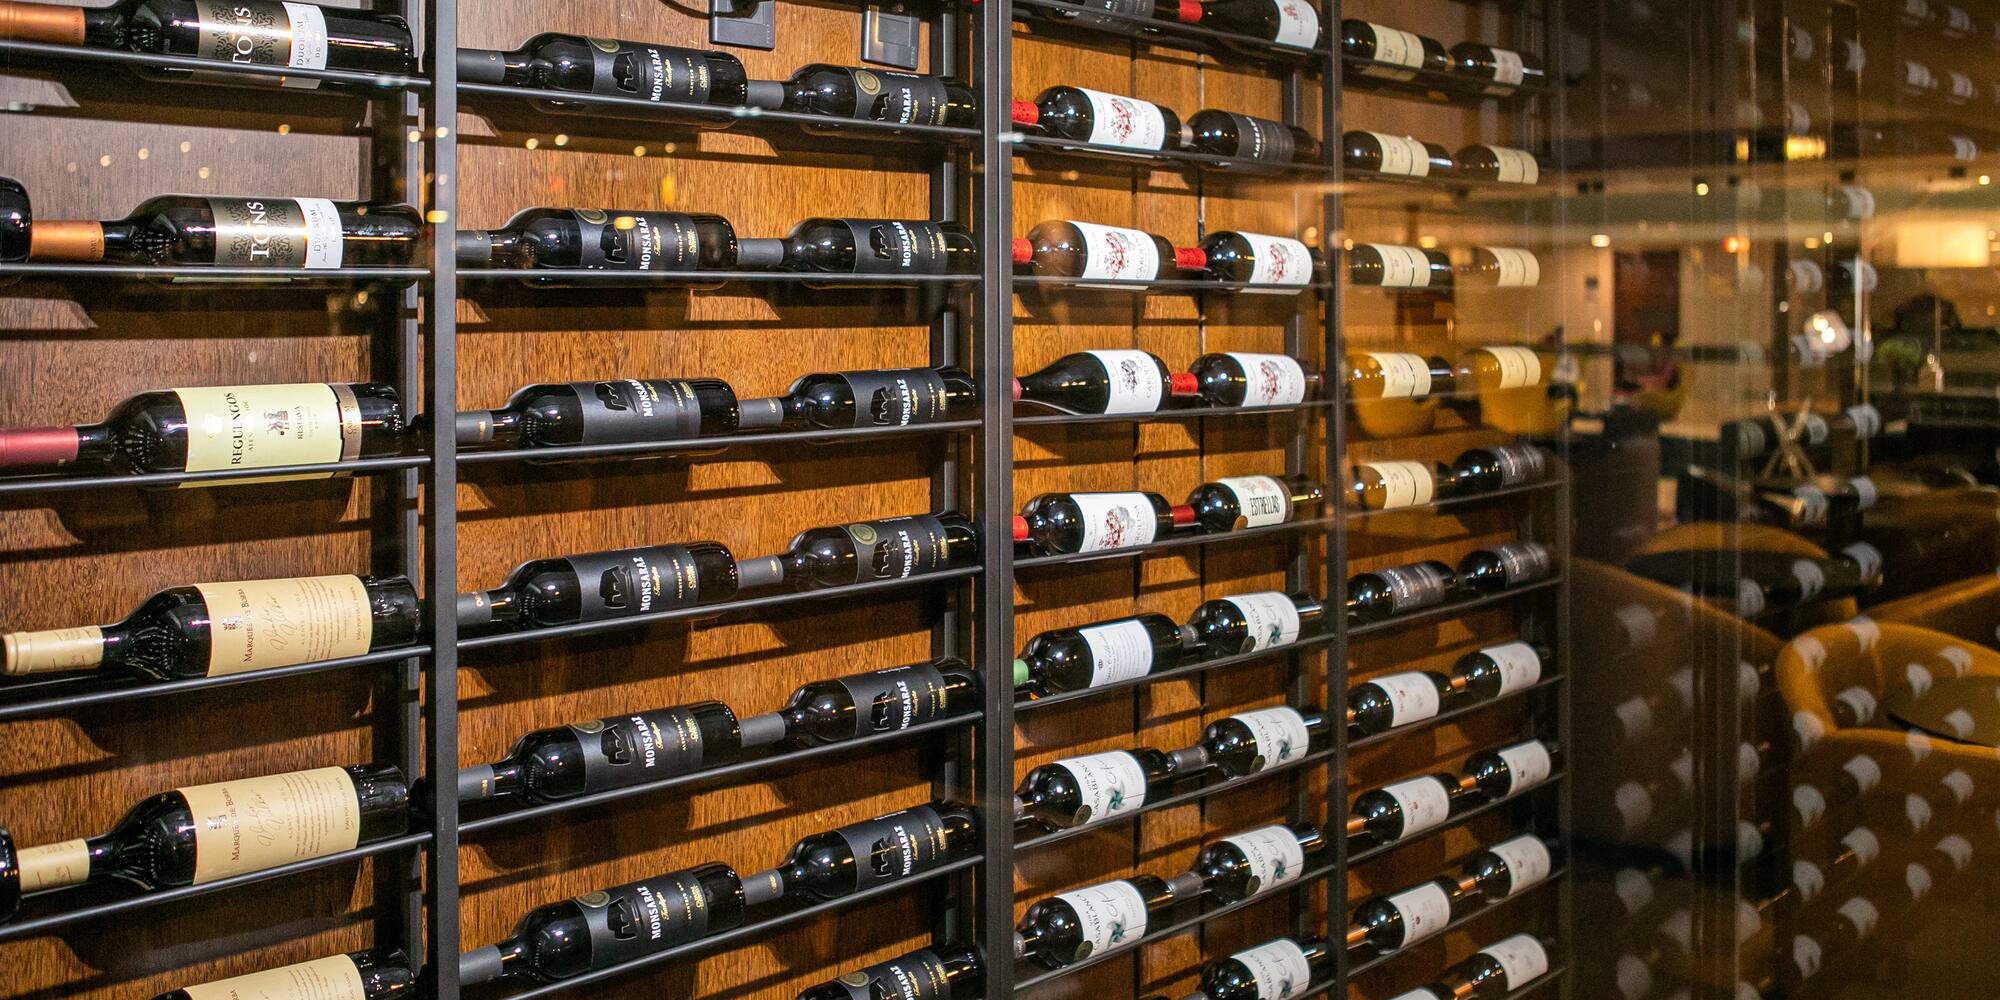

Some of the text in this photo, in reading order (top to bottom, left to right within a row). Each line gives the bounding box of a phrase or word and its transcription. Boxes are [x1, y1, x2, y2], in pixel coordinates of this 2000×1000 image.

[296, 20, 305, 66] DUOM
[648, 48, 663, 101] MONSARAZ
[900, 88, 911, 124] NSARAZ
[309, 209, 320, 251] DURUM
[636, 216, 652, 270] MONSARAZ
[1131, 233, 1145, 278] CAROLI
[624, 378, 653, 417] MONSARA
[294, 406, 304, 440] RESERVA
[1249, 495, 1281, 517] ESTRELLAS
[238, 587, 250, 608] BORBA
[632, 556, 651, 611] MONSARAZ
[630, 715, 655, 768] MONSARAZ
[1249, 715, 1272, 766] CASABLAN
[221, 787, 234, 807] BORBA
[231, 820, 242, 861] MARQU
[893, 825, 911, 876] MONSARAZ
[636, 885, 661, 940] MONSARAZ
[889, 965, 914, 1000] ONSARAZ
